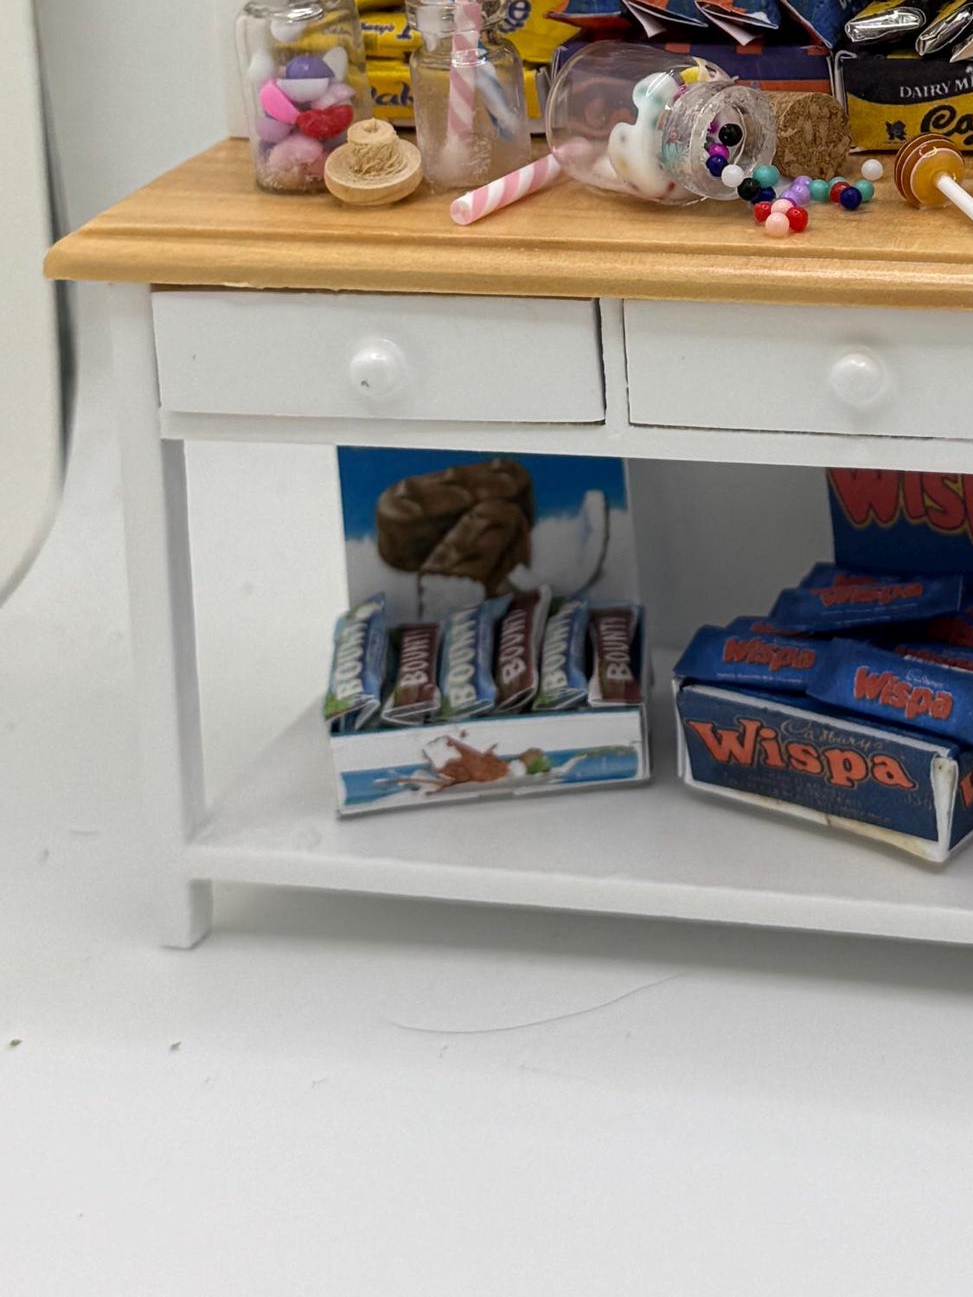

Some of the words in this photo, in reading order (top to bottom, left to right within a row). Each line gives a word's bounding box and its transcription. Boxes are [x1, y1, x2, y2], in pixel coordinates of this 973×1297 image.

[901, 77, 949, 99] DAIRY
[722, 636, 817, 672] Wispa
[852, 665, 955, 720] Wispa
[686, 716, 918, 789] Wispa
